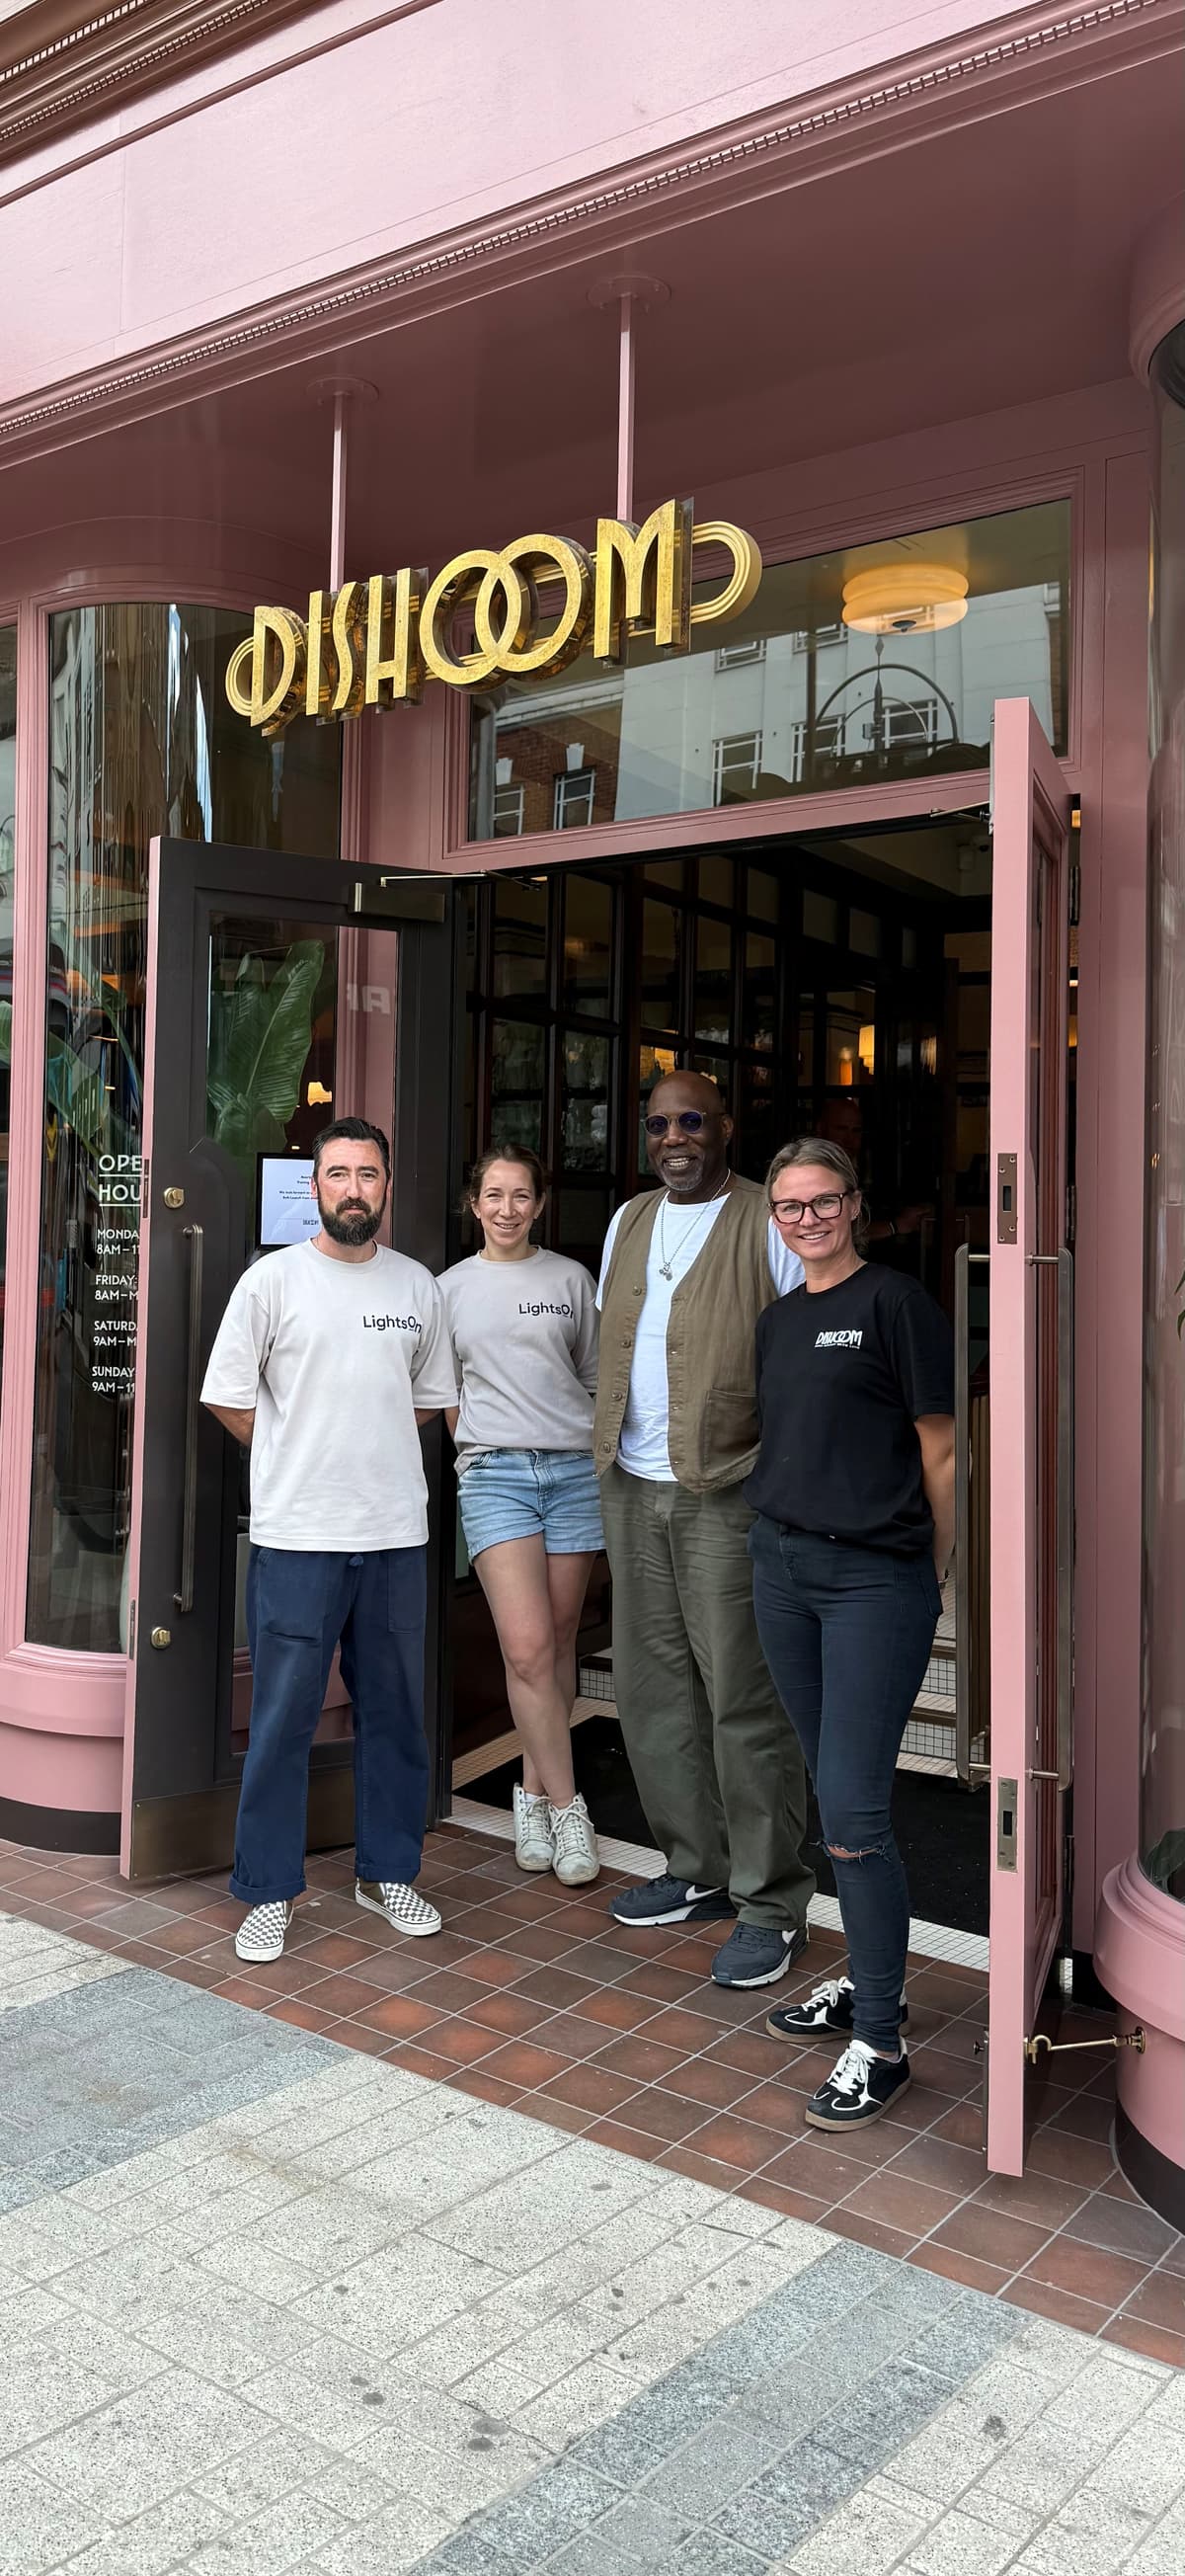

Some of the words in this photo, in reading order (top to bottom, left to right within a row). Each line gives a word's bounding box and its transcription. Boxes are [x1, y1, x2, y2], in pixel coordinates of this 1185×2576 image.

[250, 497, 693, 733] DISHOOM
[99, 1154, 142, 1171] OPE
[99, 1183, 142, 1202] HOU
[97, 1229, 140, 1240] MONDA
[95, 1274, 138, 1285] FRIDAY:
[94, 1320, 139, 1331] SATURD
[362, 1315, 423, 1333] LightsOn
